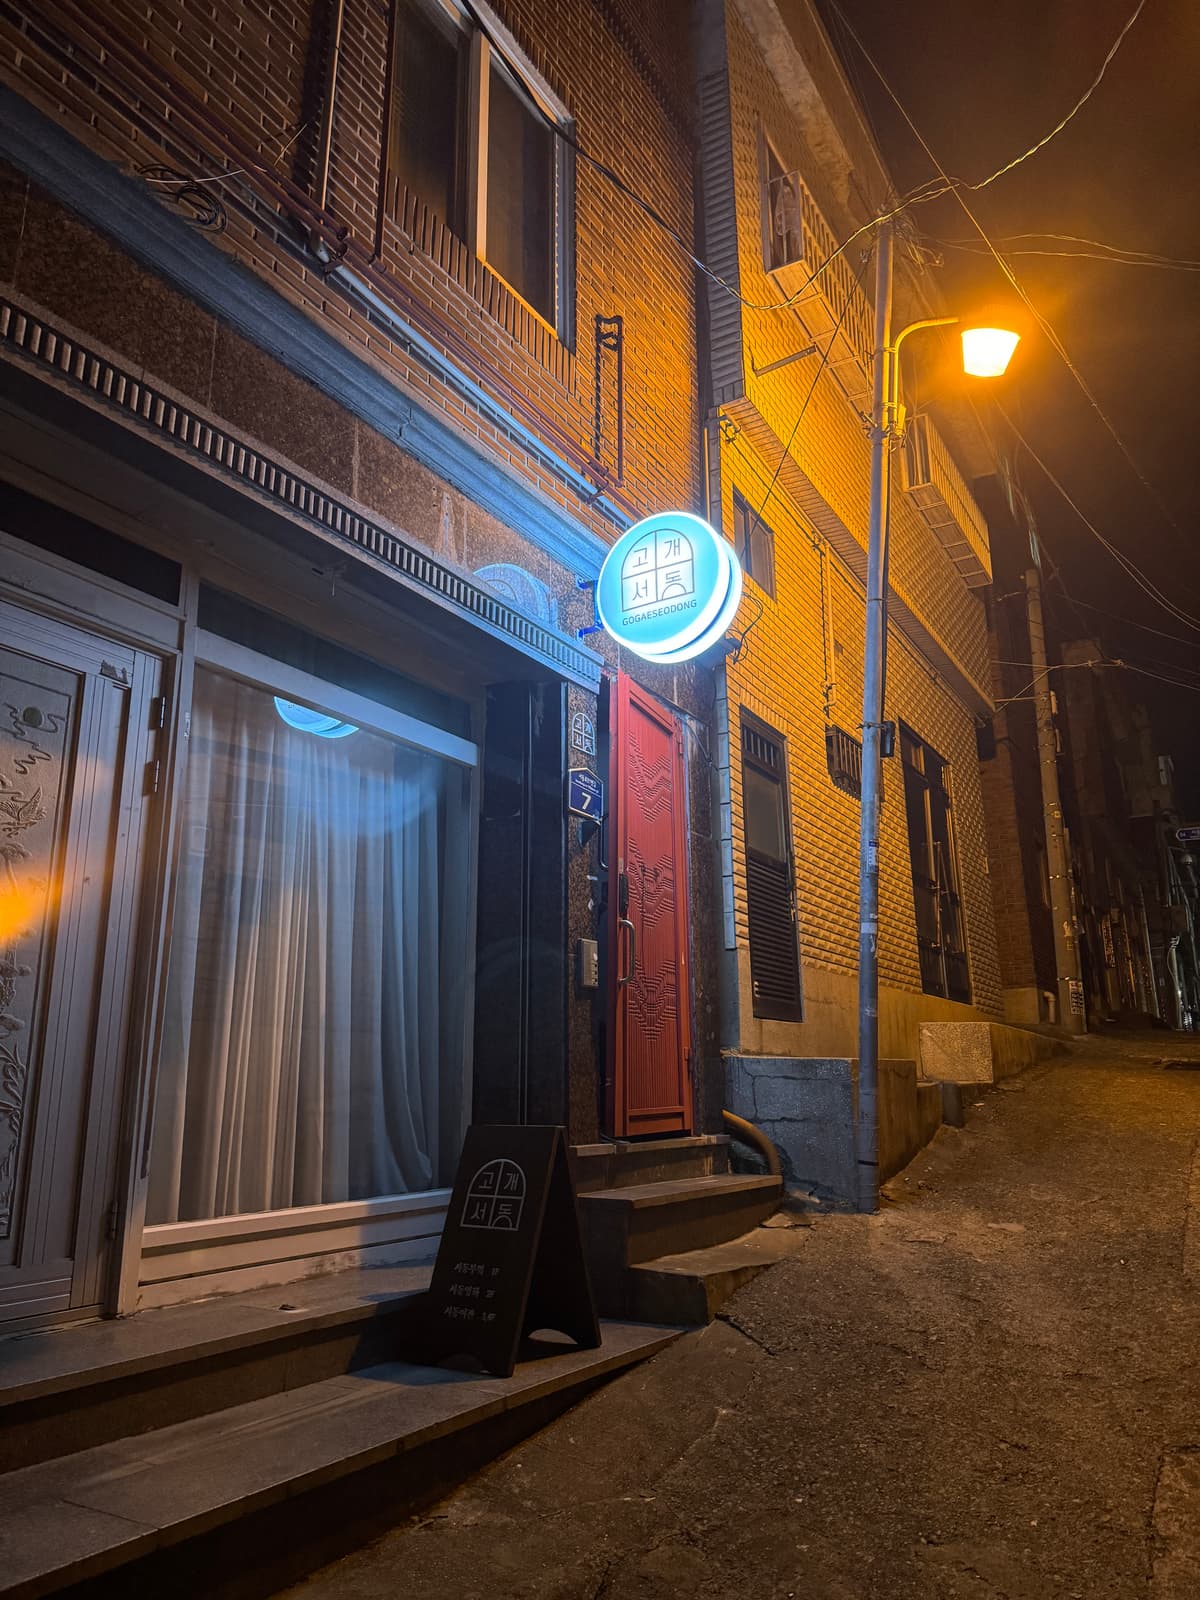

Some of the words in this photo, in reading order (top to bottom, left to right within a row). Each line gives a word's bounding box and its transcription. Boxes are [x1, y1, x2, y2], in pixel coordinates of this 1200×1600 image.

[632, 538, 681, 568] 고개
[632, 570, 687, 601] 서동
[622, 599, 697, 626] GOGAESEODONG
[581, 792, 592, 810] 7
[479, 1172, 519, 1191] 고개
[470, 1201, 513, 1229] 서동
